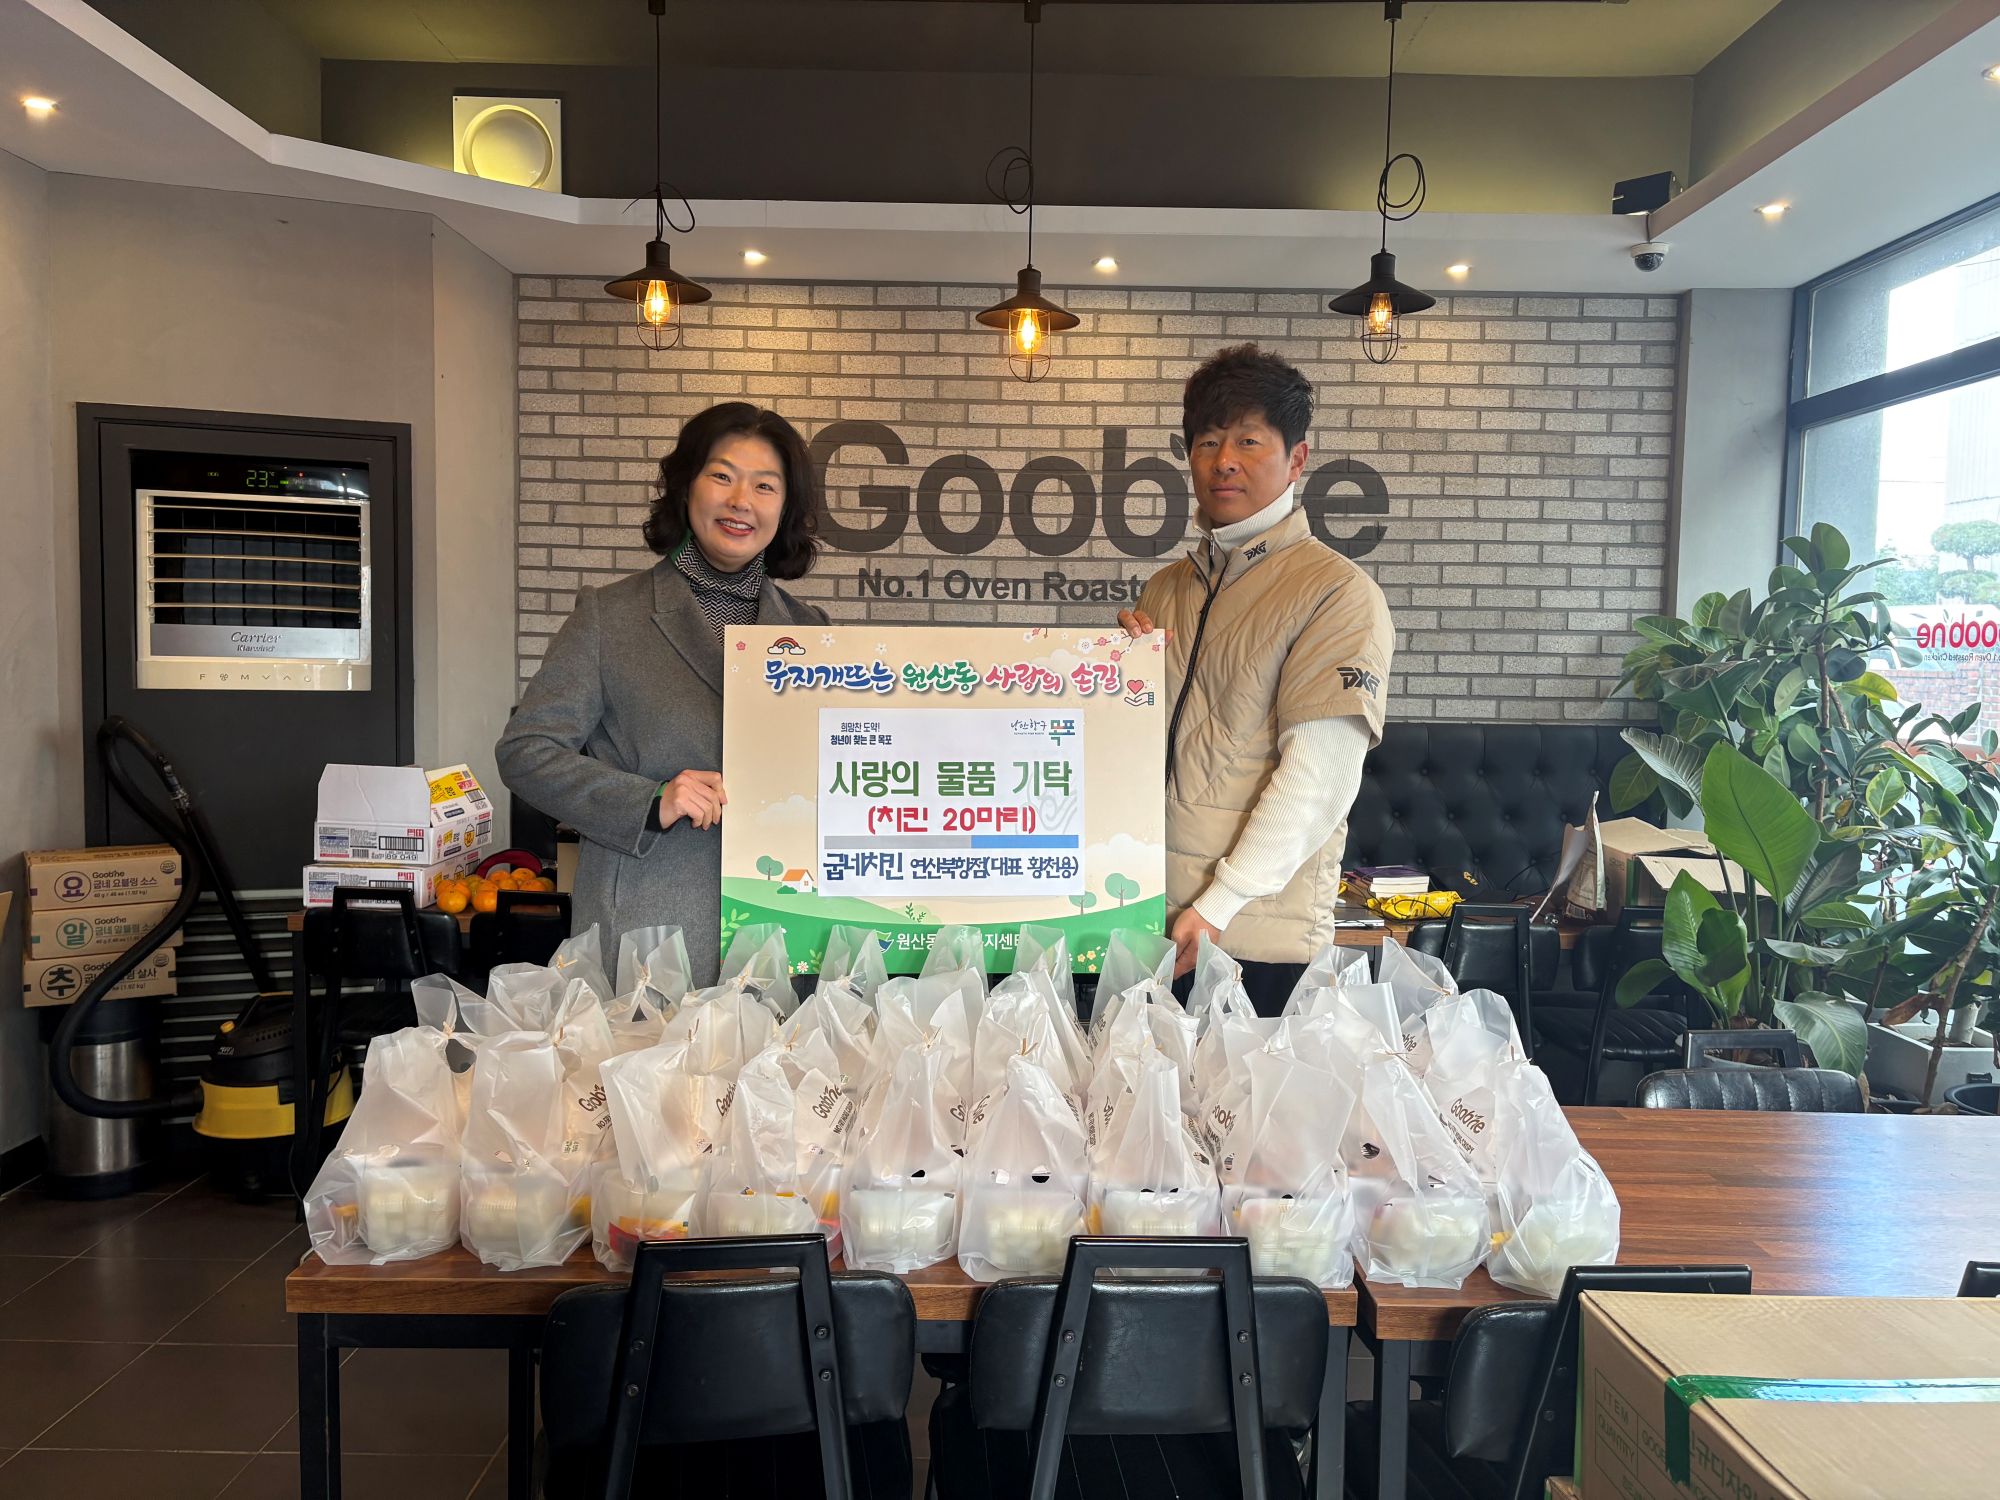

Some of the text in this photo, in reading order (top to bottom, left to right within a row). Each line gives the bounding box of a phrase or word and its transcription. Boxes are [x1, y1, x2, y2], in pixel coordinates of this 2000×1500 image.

[808, 420, 1390, 558] Goobe
[858, 568, 1147, 602] No.1 Oven Roast
[230, 631, 282, 643] Carrier
[764, 660, 1121, 693] 무지개뜨는 원산동 사랑의 손길
[830, 734, 893, 746] 청년이 찾는 큰 목포
[840, 722, 880, 733] 희망찬 도약!
[1048, 719, 1076, 747] 목포
[829, 760, 1073, 797] 사랑의 물품 기탁
[868, 805, 1036, 834] (치킨 20마리)
[823, 851, 904, 880] 굽네치킨
[62, 876, 85, 898] 요
[140, 877, 157, 886] 소스
[63, 922, 87, 945] 알
[47, 967, 75, 996] 추
[1451, 1097, 1486, 1134] Goobne
[1602, 1389, 1629, 1425] ITEM
